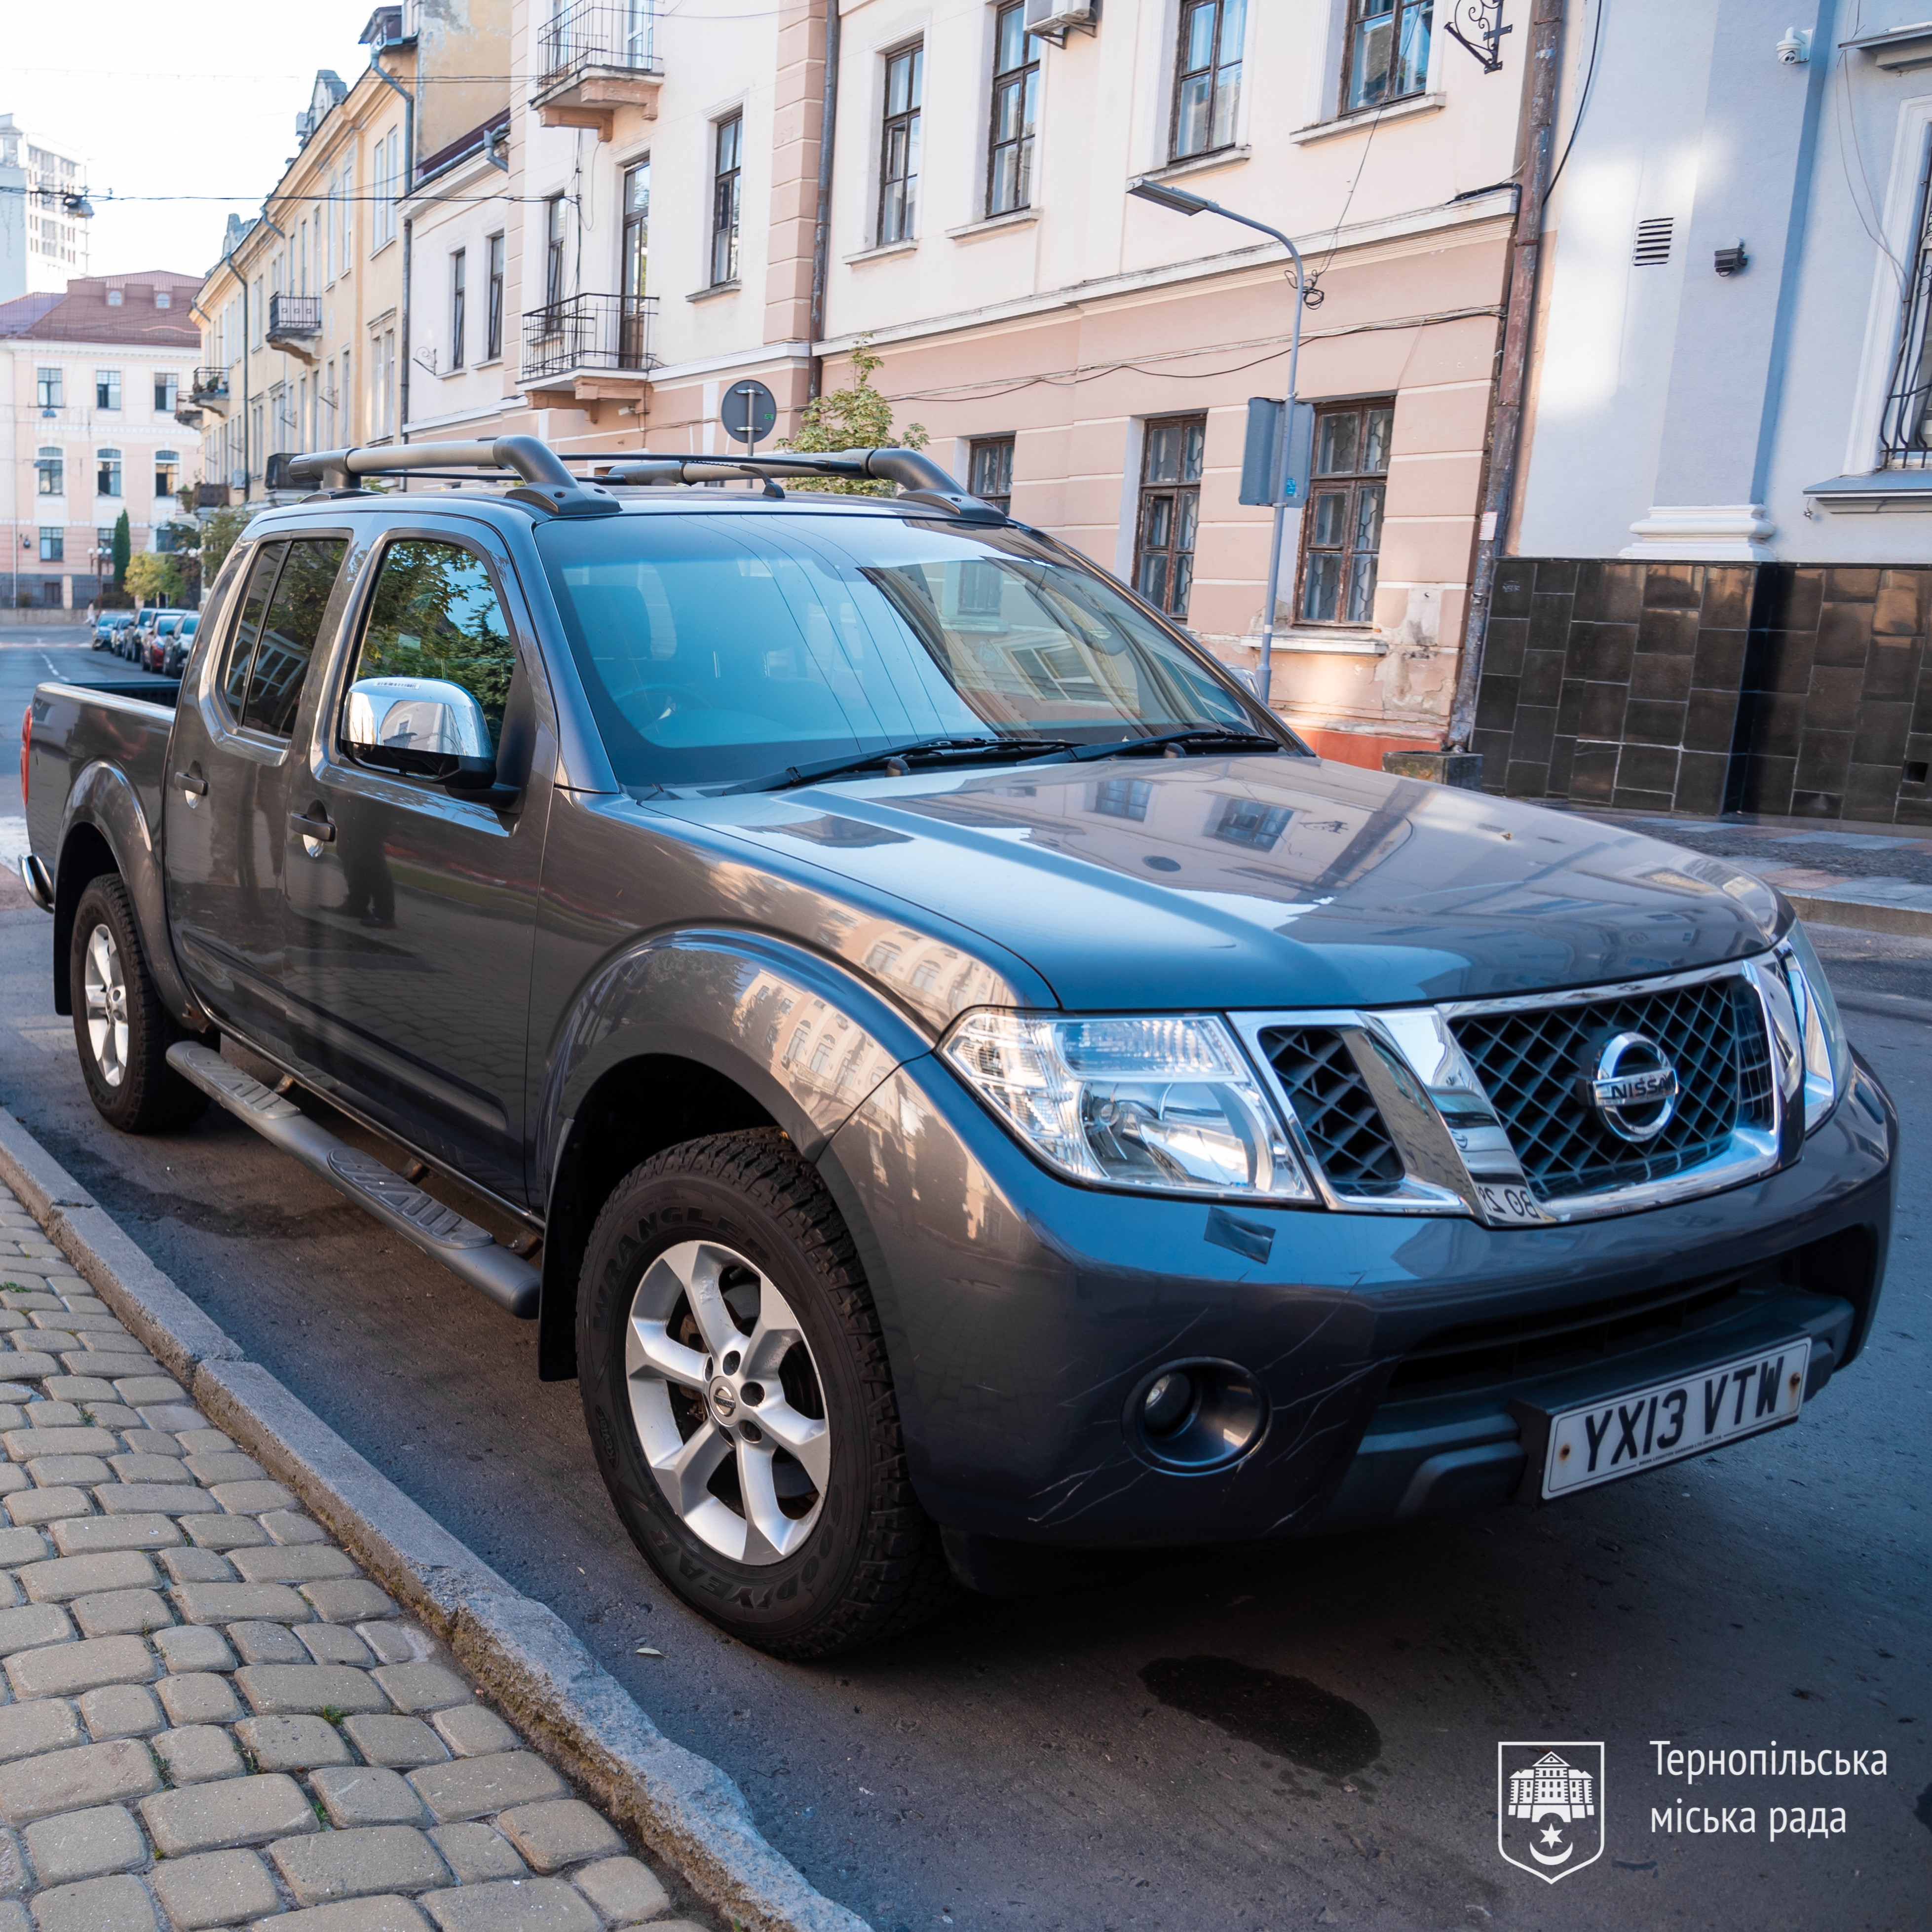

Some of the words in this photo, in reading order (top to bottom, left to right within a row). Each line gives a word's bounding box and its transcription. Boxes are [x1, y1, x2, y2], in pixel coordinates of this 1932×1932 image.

[1611, 1071, 1675, 1099] NISSAN
[592, 1205, 771, 1331] WRANGLER
[1585, 1388, 1688, 1473] YX13
[1704, 1356, 1784, 1435] VTW
[649, 1484, 843, 1609] GOODYEAR
